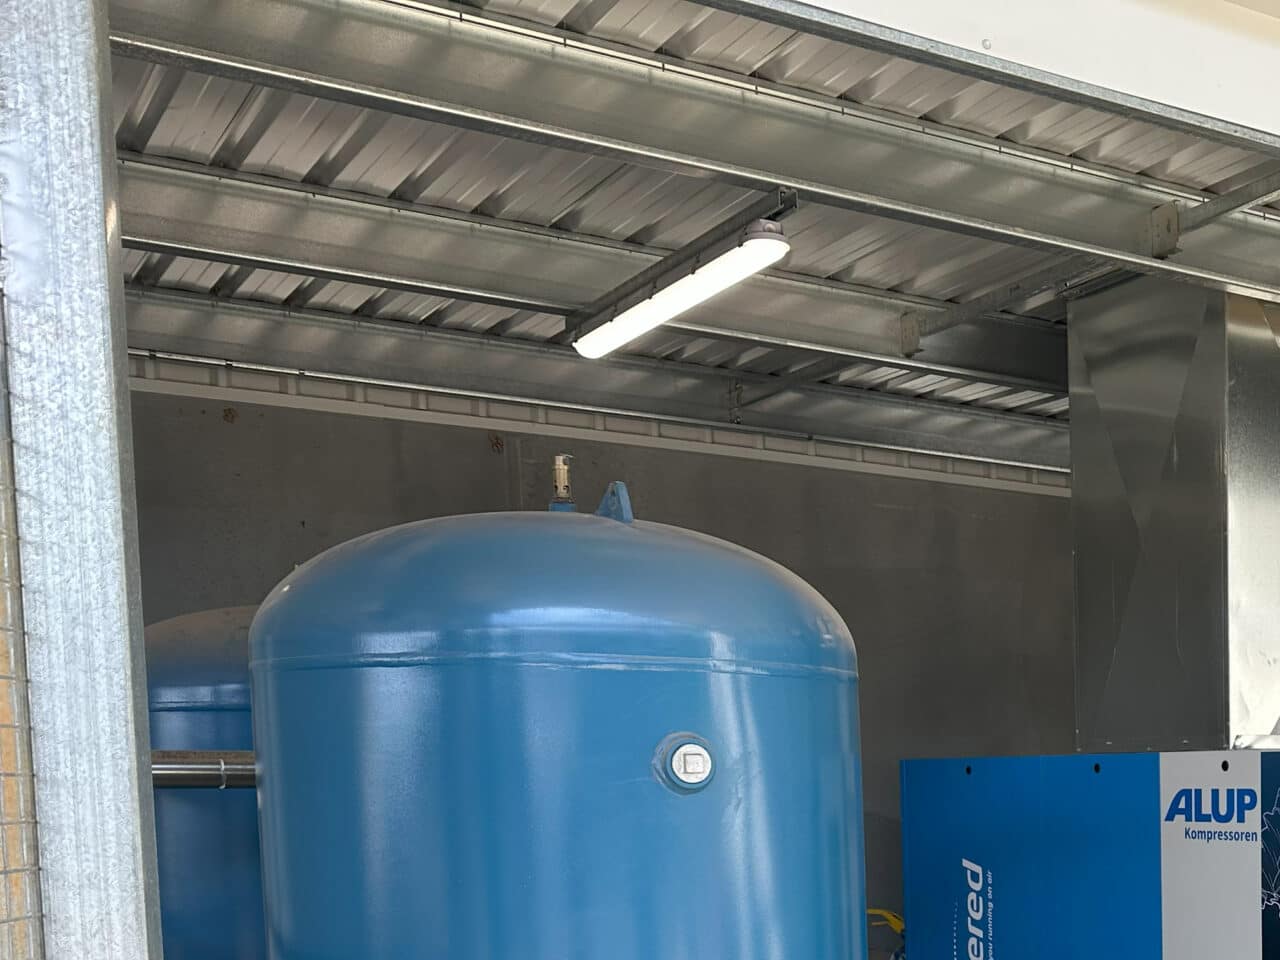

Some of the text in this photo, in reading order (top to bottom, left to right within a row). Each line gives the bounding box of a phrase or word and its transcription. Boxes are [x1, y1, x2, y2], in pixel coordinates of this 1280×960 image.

[1164, 788, 1258, 824] ALUP
[1184, 827, 1258, 843] Kompressoren
[986, 901, 994, 941] running
